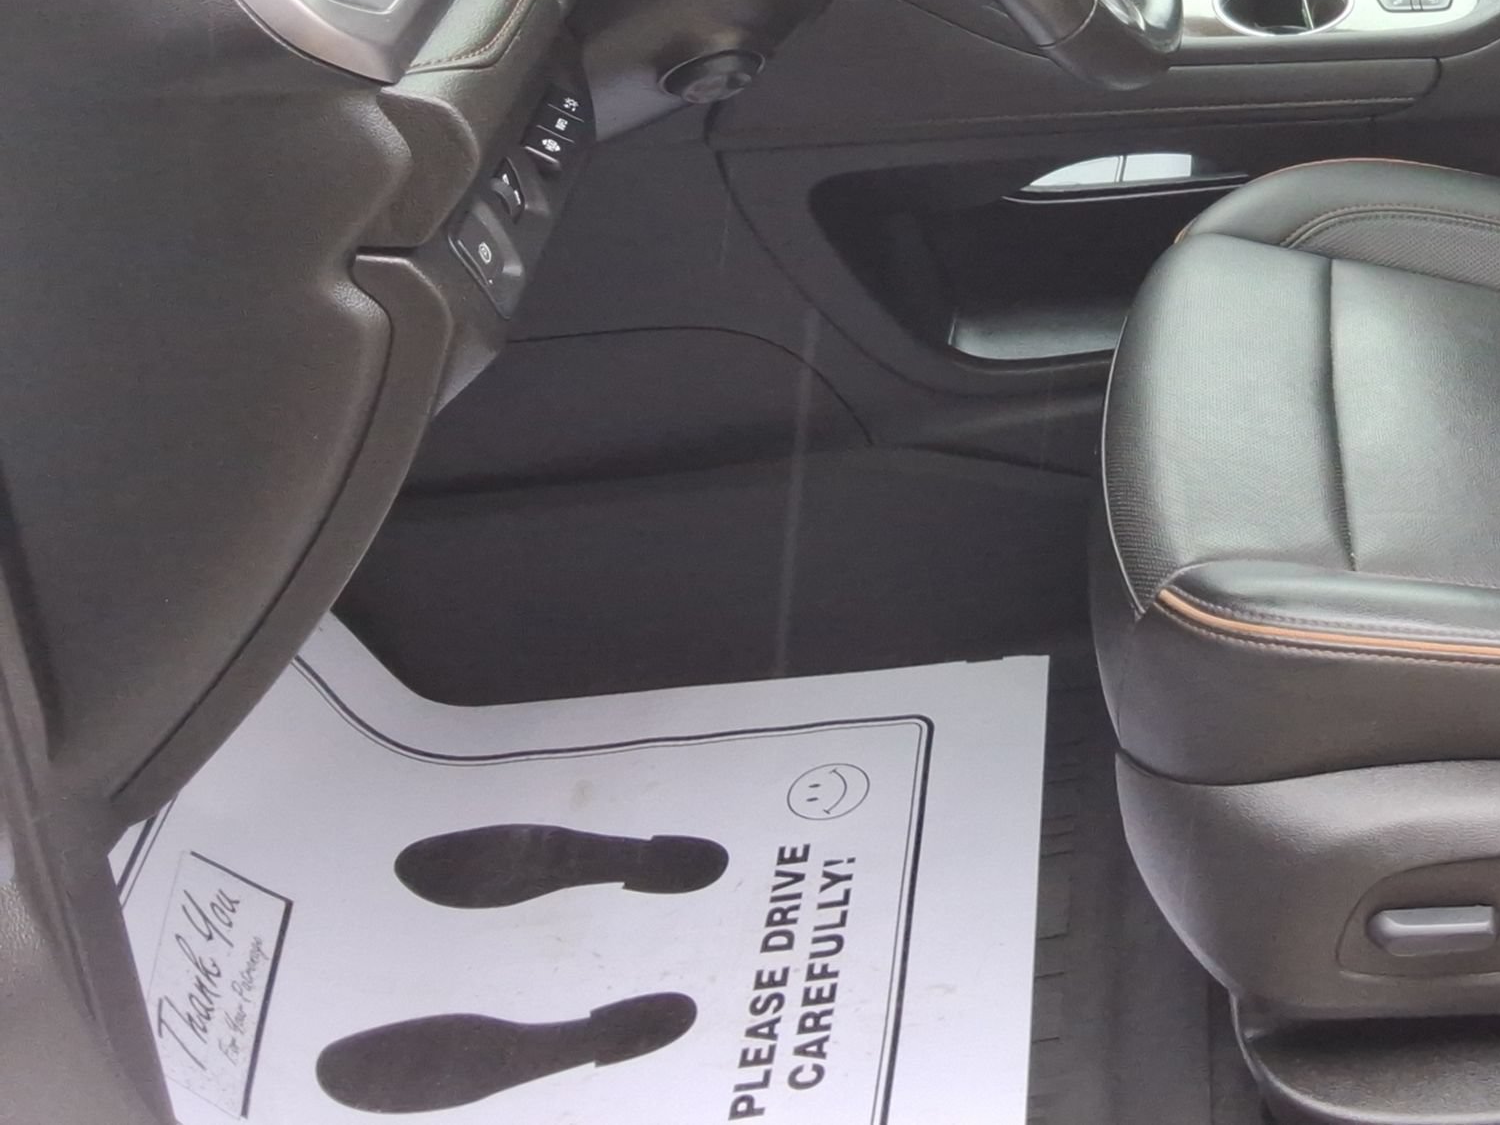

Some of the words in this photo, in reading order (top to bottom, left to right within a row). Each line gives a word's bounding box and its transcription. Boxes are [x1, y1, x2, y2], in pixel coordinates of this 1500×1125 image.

[182, 889, 241, 948] You
[157, 933, 222, 1072] Thank
[225, 1004, 249, 1035] Your
[728, 966, 790, 1121] PLEASE
[760, 843, 811, 953] DRIVE
[787, 857, 856, 1091] CAREFULLY!
[218, 1035, 241, 1066] For
